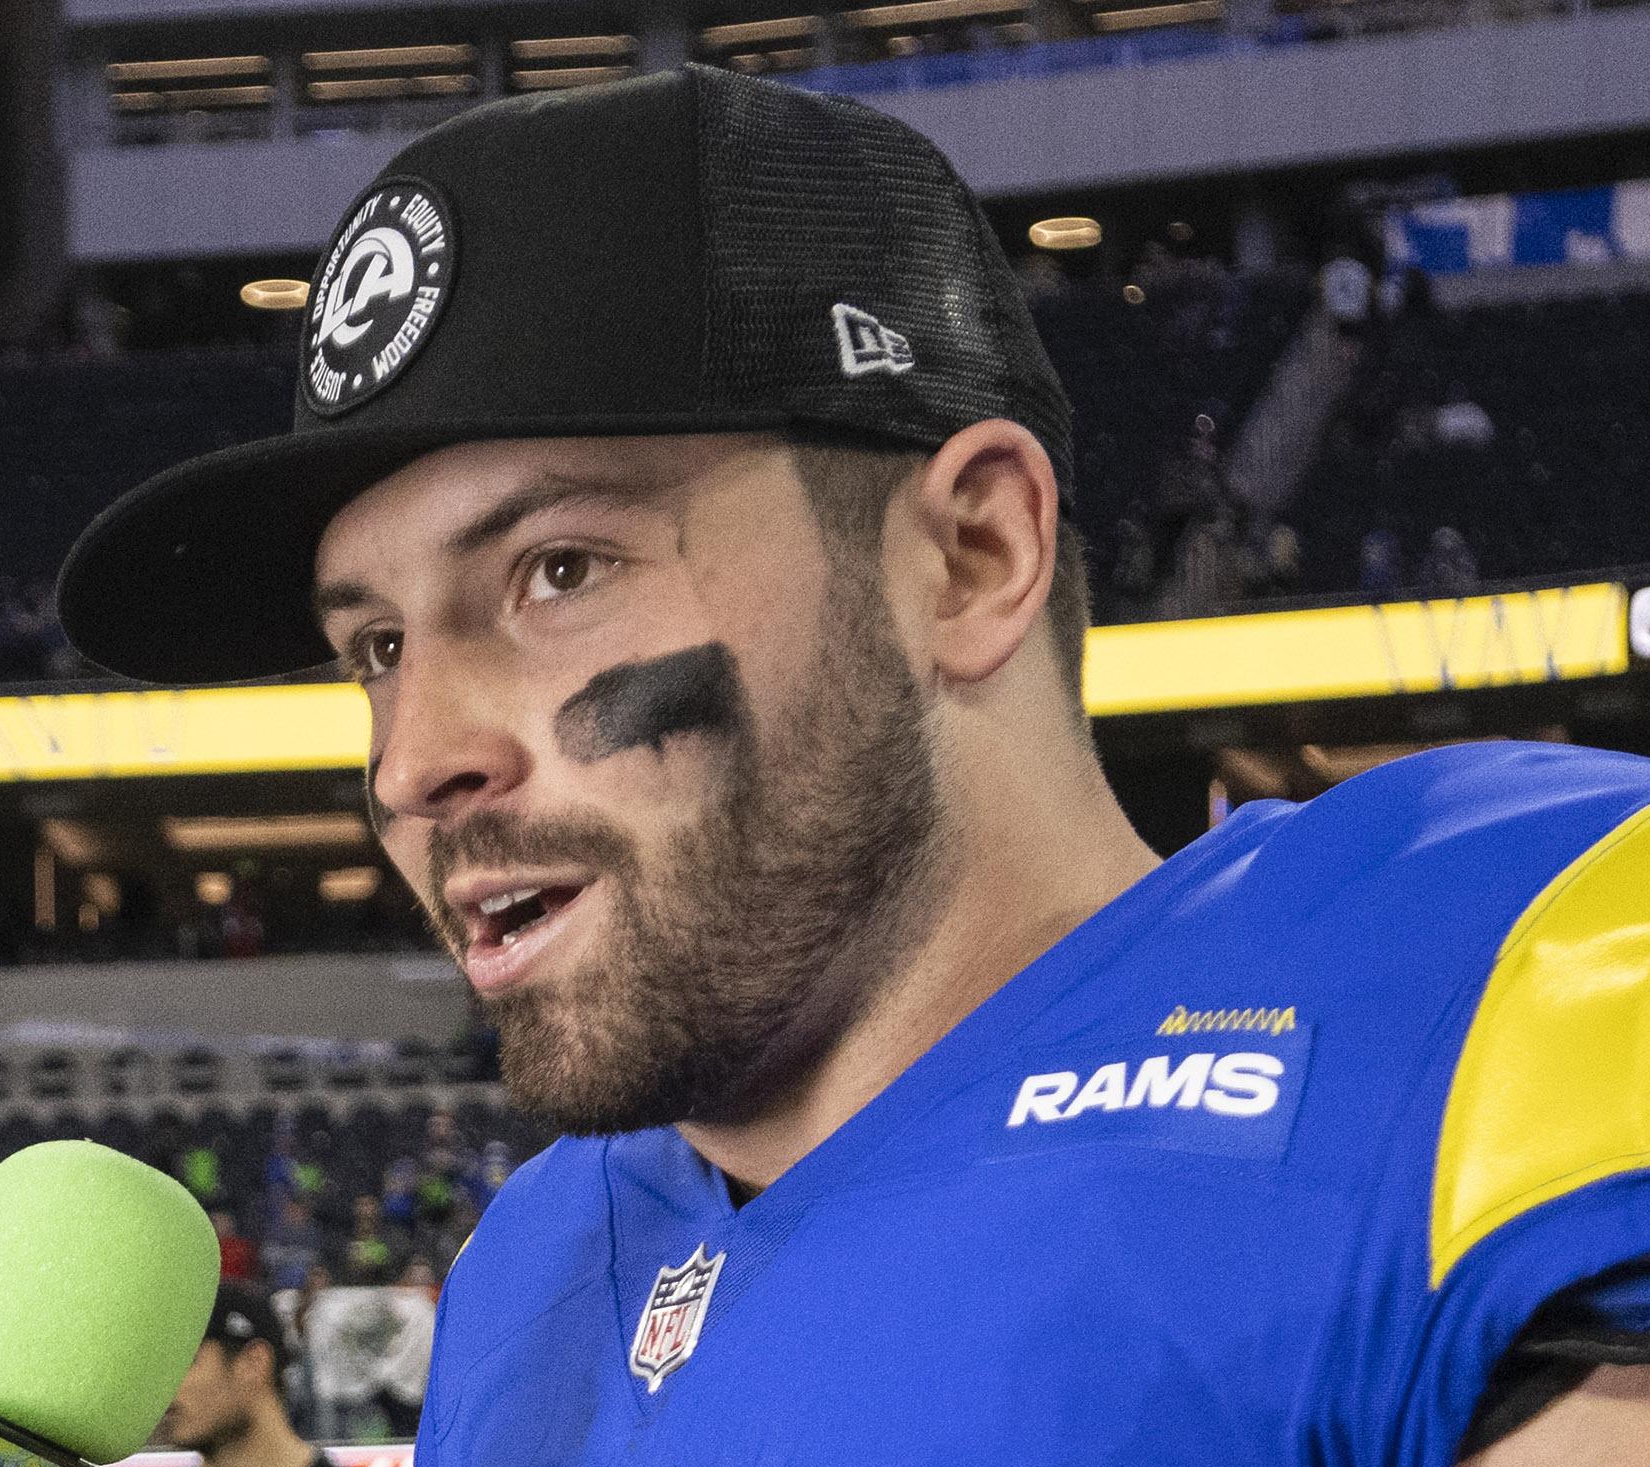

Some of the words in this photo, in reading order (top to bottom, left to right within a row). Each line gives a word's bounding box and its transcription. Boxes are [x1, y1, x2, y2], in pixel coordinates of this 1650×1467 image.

[400, 193, 445, 253] EQUITY
[311, 193, 383, 323] OPPORTUNITY
[371, 285, 441, 381] FREEDOM
[309, 347, 347, 401] JUSTICE
[1005, 1052, 1285, 1128] RAMS
[640, 1303, 692, 1361] NFL
